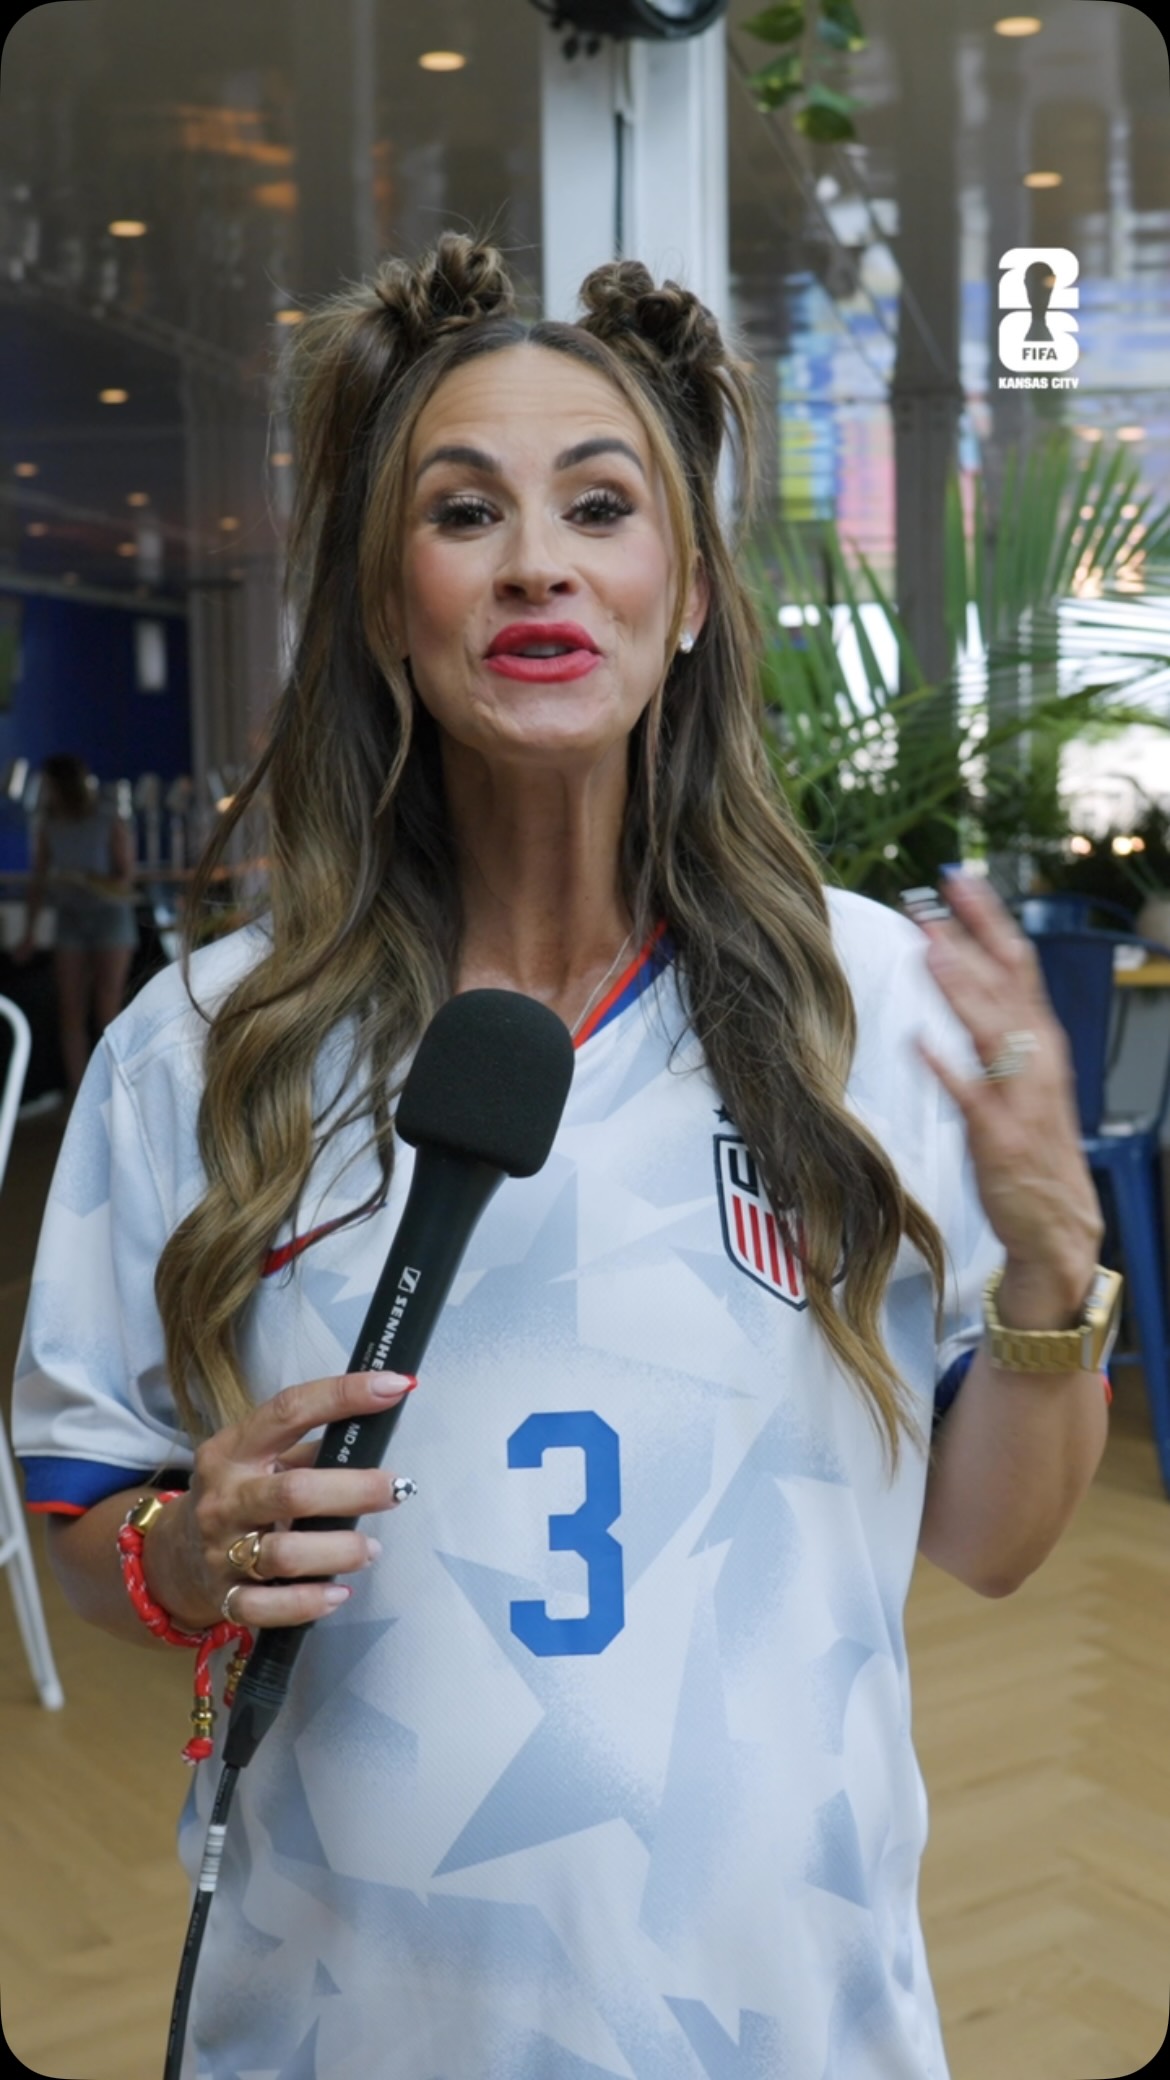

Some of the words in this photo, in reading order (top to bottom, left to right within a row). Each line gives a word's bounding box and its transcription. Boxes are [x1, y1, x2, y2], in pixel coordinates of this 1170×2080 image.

[371, 1294, 408, 1373] SENNHE
[337, 1447, 351, 1464] 46
[344, 1423, 361, 1445] MD
[507, 1410, 625, 1657] 3
